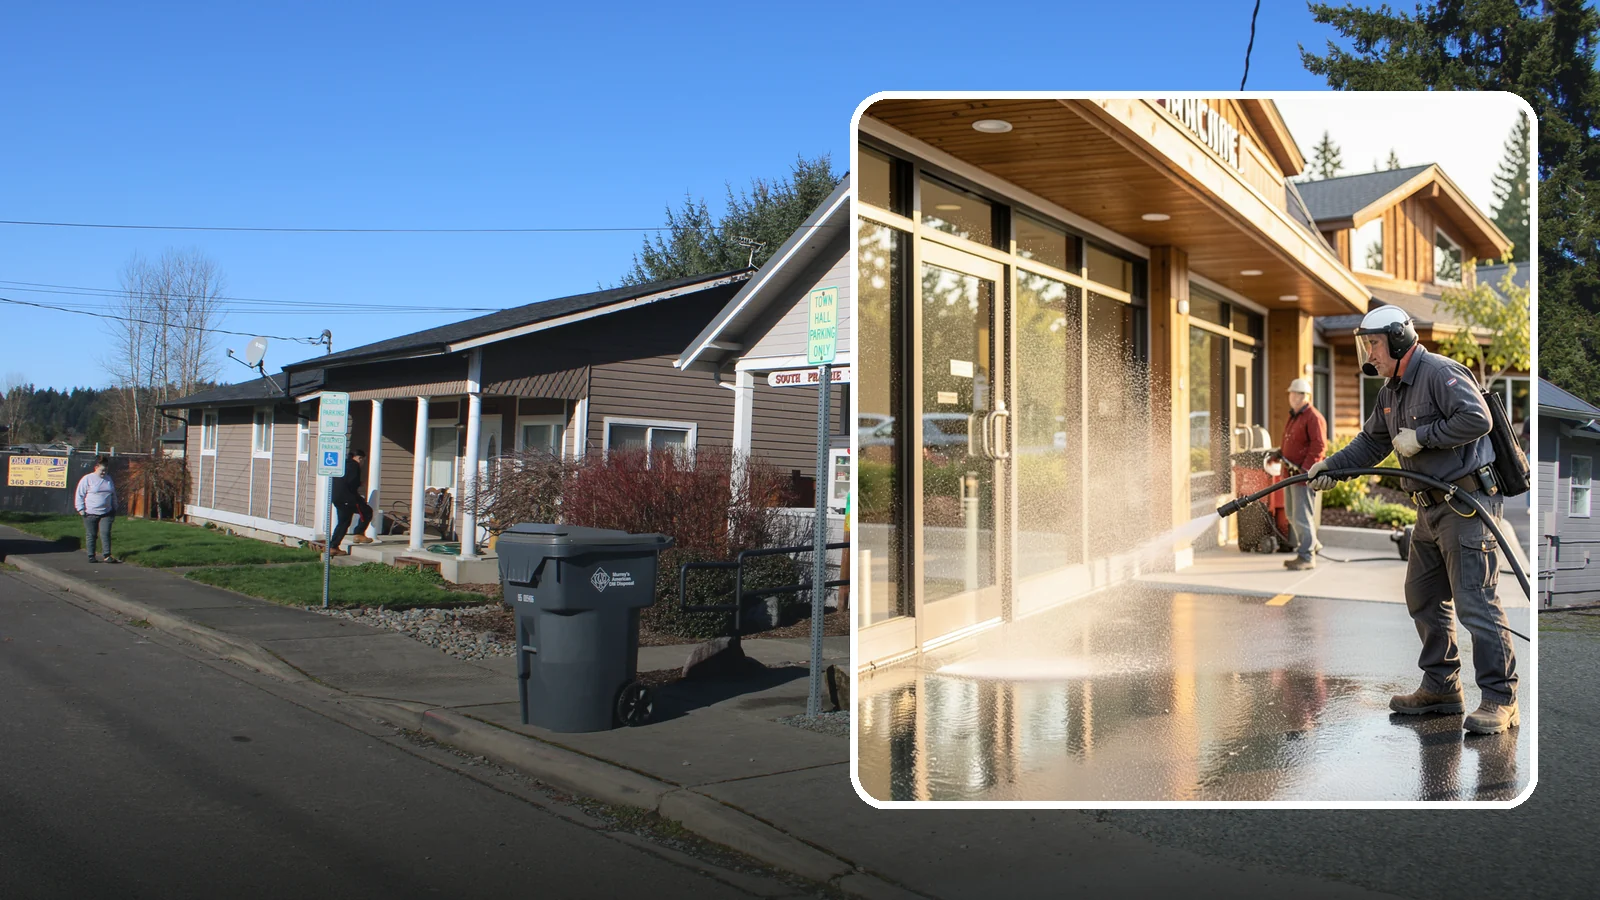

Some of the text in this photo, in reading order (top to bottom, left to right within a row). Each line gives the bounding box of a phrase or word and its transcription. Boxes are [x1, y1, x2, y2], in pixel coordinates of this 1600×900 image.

[815, 294, 833, 308] TOWN
[814, 312, 831, 325] HALL
[809, 326, 836, 341] PARKING
[814, 344, 831, 357] ONLY
[776, 374, 801, 384] SOUTH
